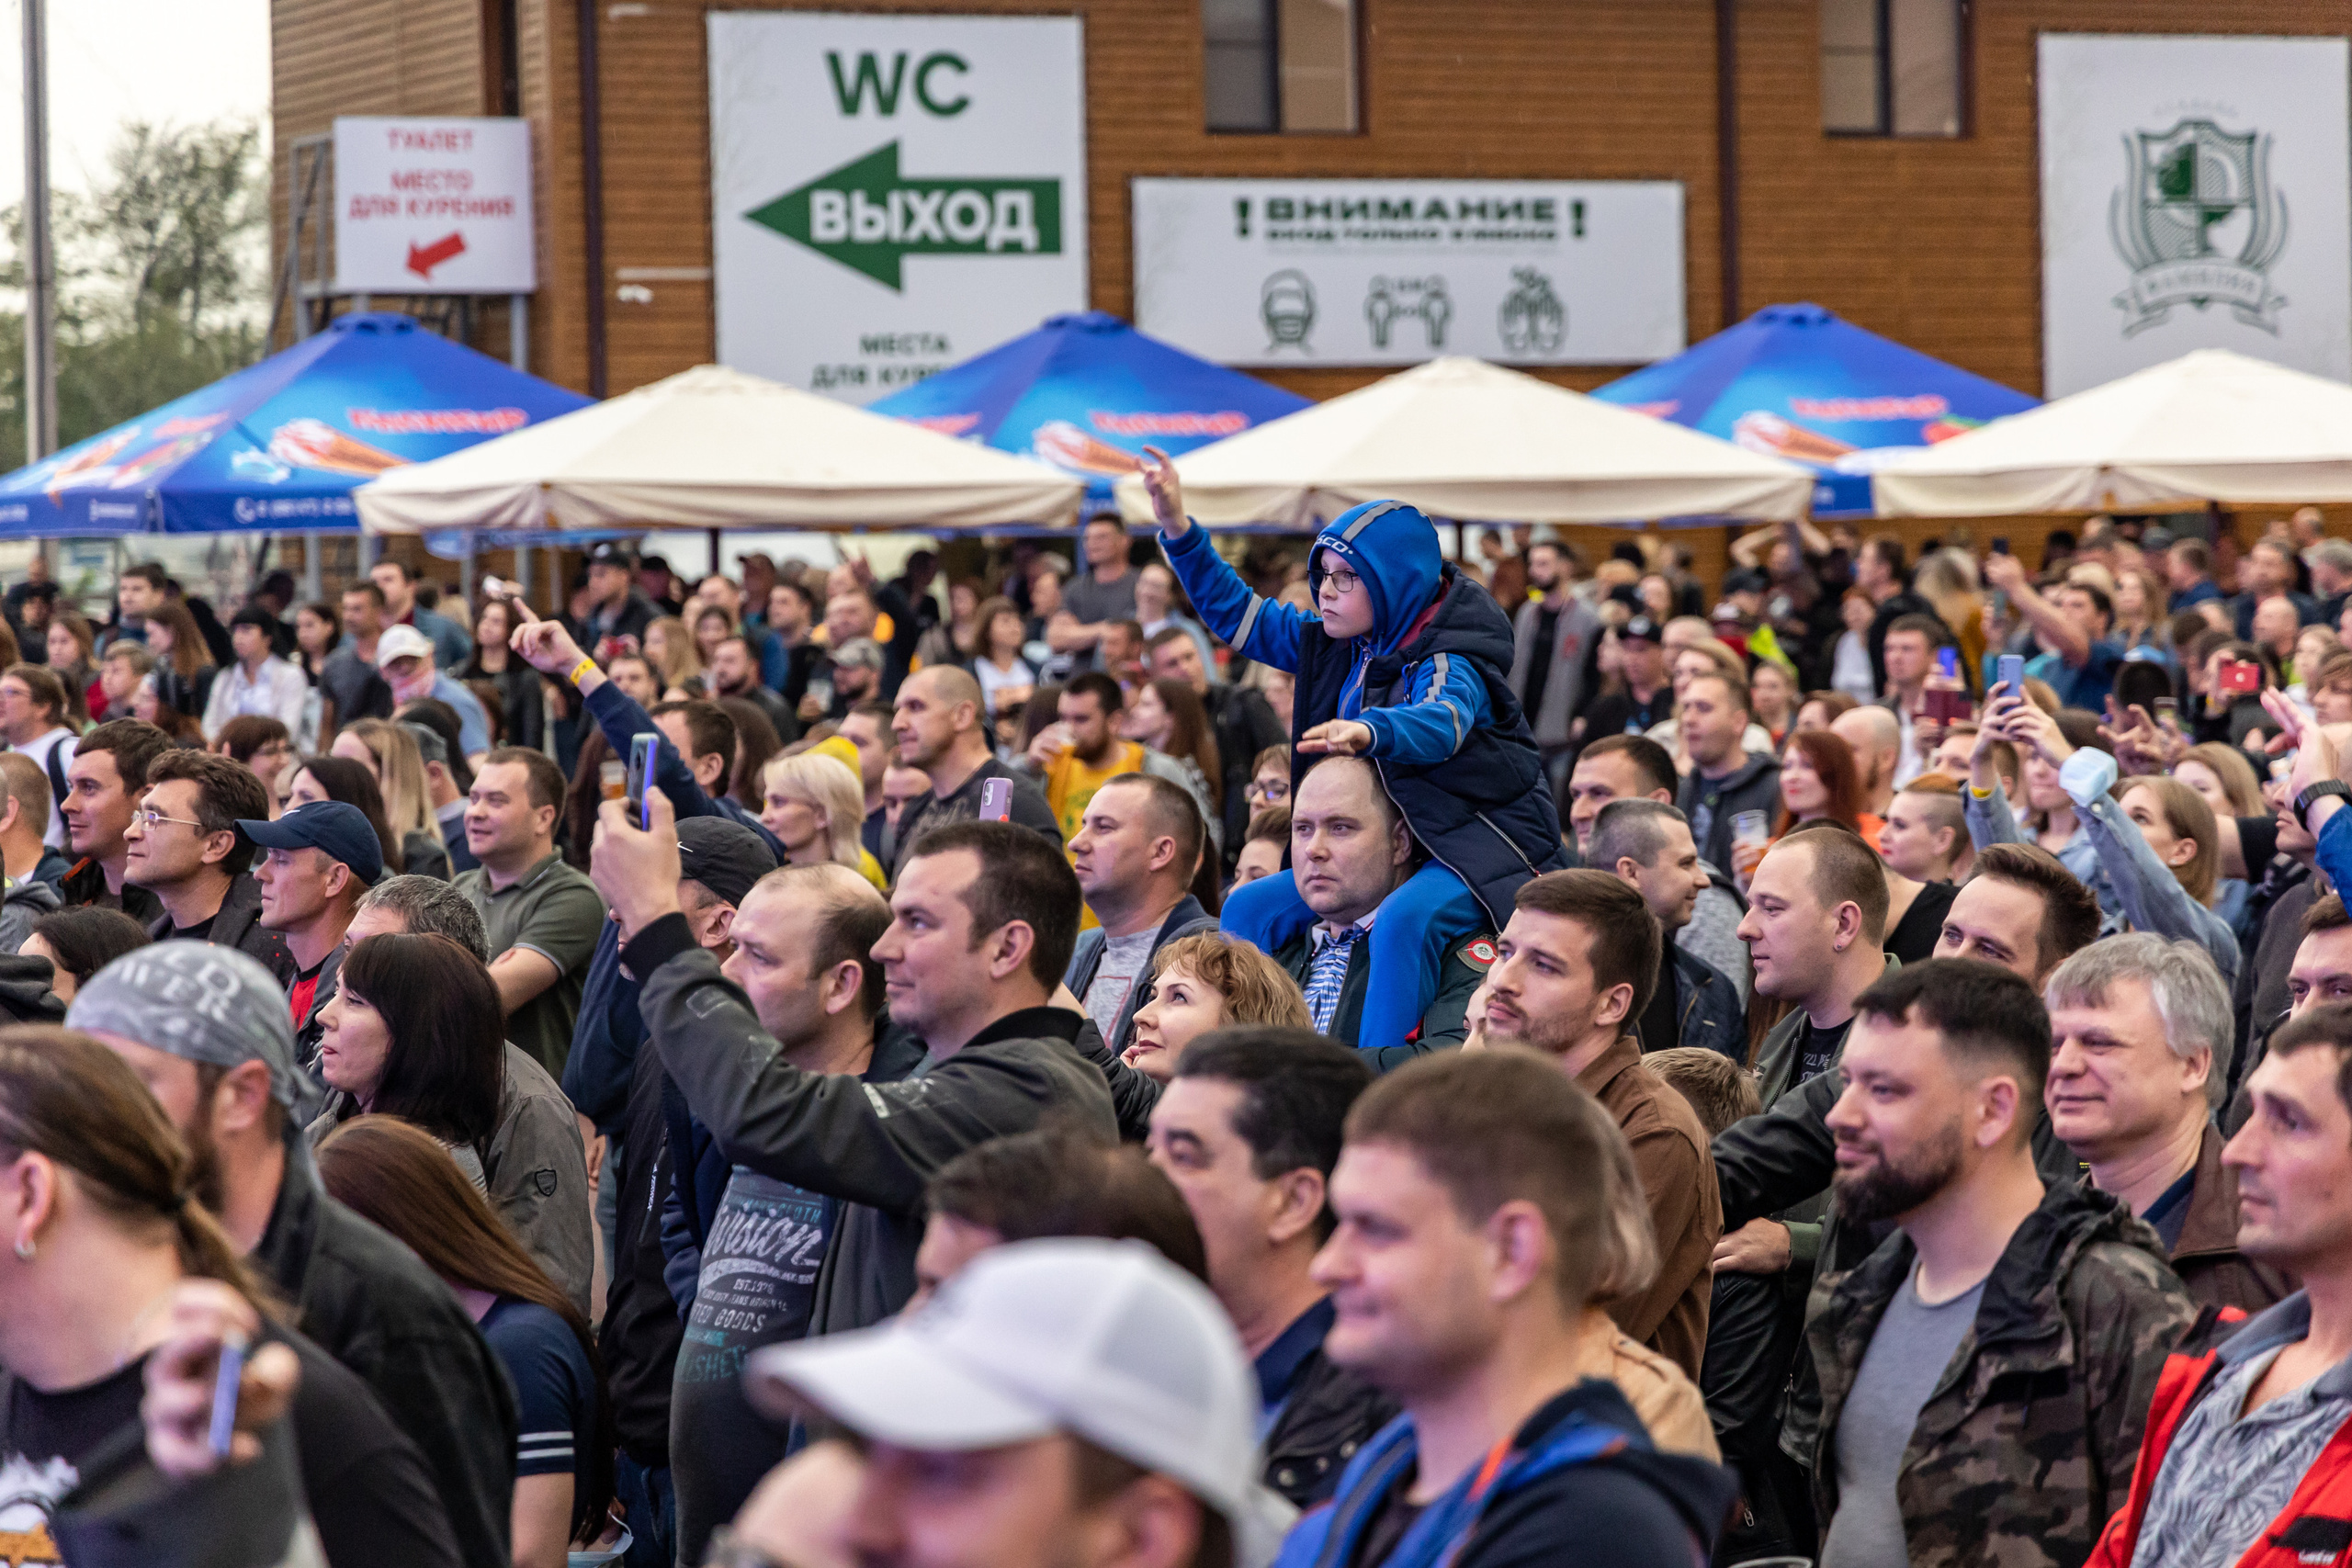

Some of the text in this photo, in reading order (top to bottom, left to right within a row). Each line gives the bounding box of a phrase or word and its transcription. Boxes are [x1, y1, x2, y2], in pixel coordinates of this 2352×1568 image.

[824, 50, 971, 118] WC
[808, 188, 1040, 252] ВЫХОД
[1265, 196, 1557, 222] ВНИМАНИЕ
[858, 332, 951, 357] МЕСТА
[714, 1306, 767, 1334] GOODS
